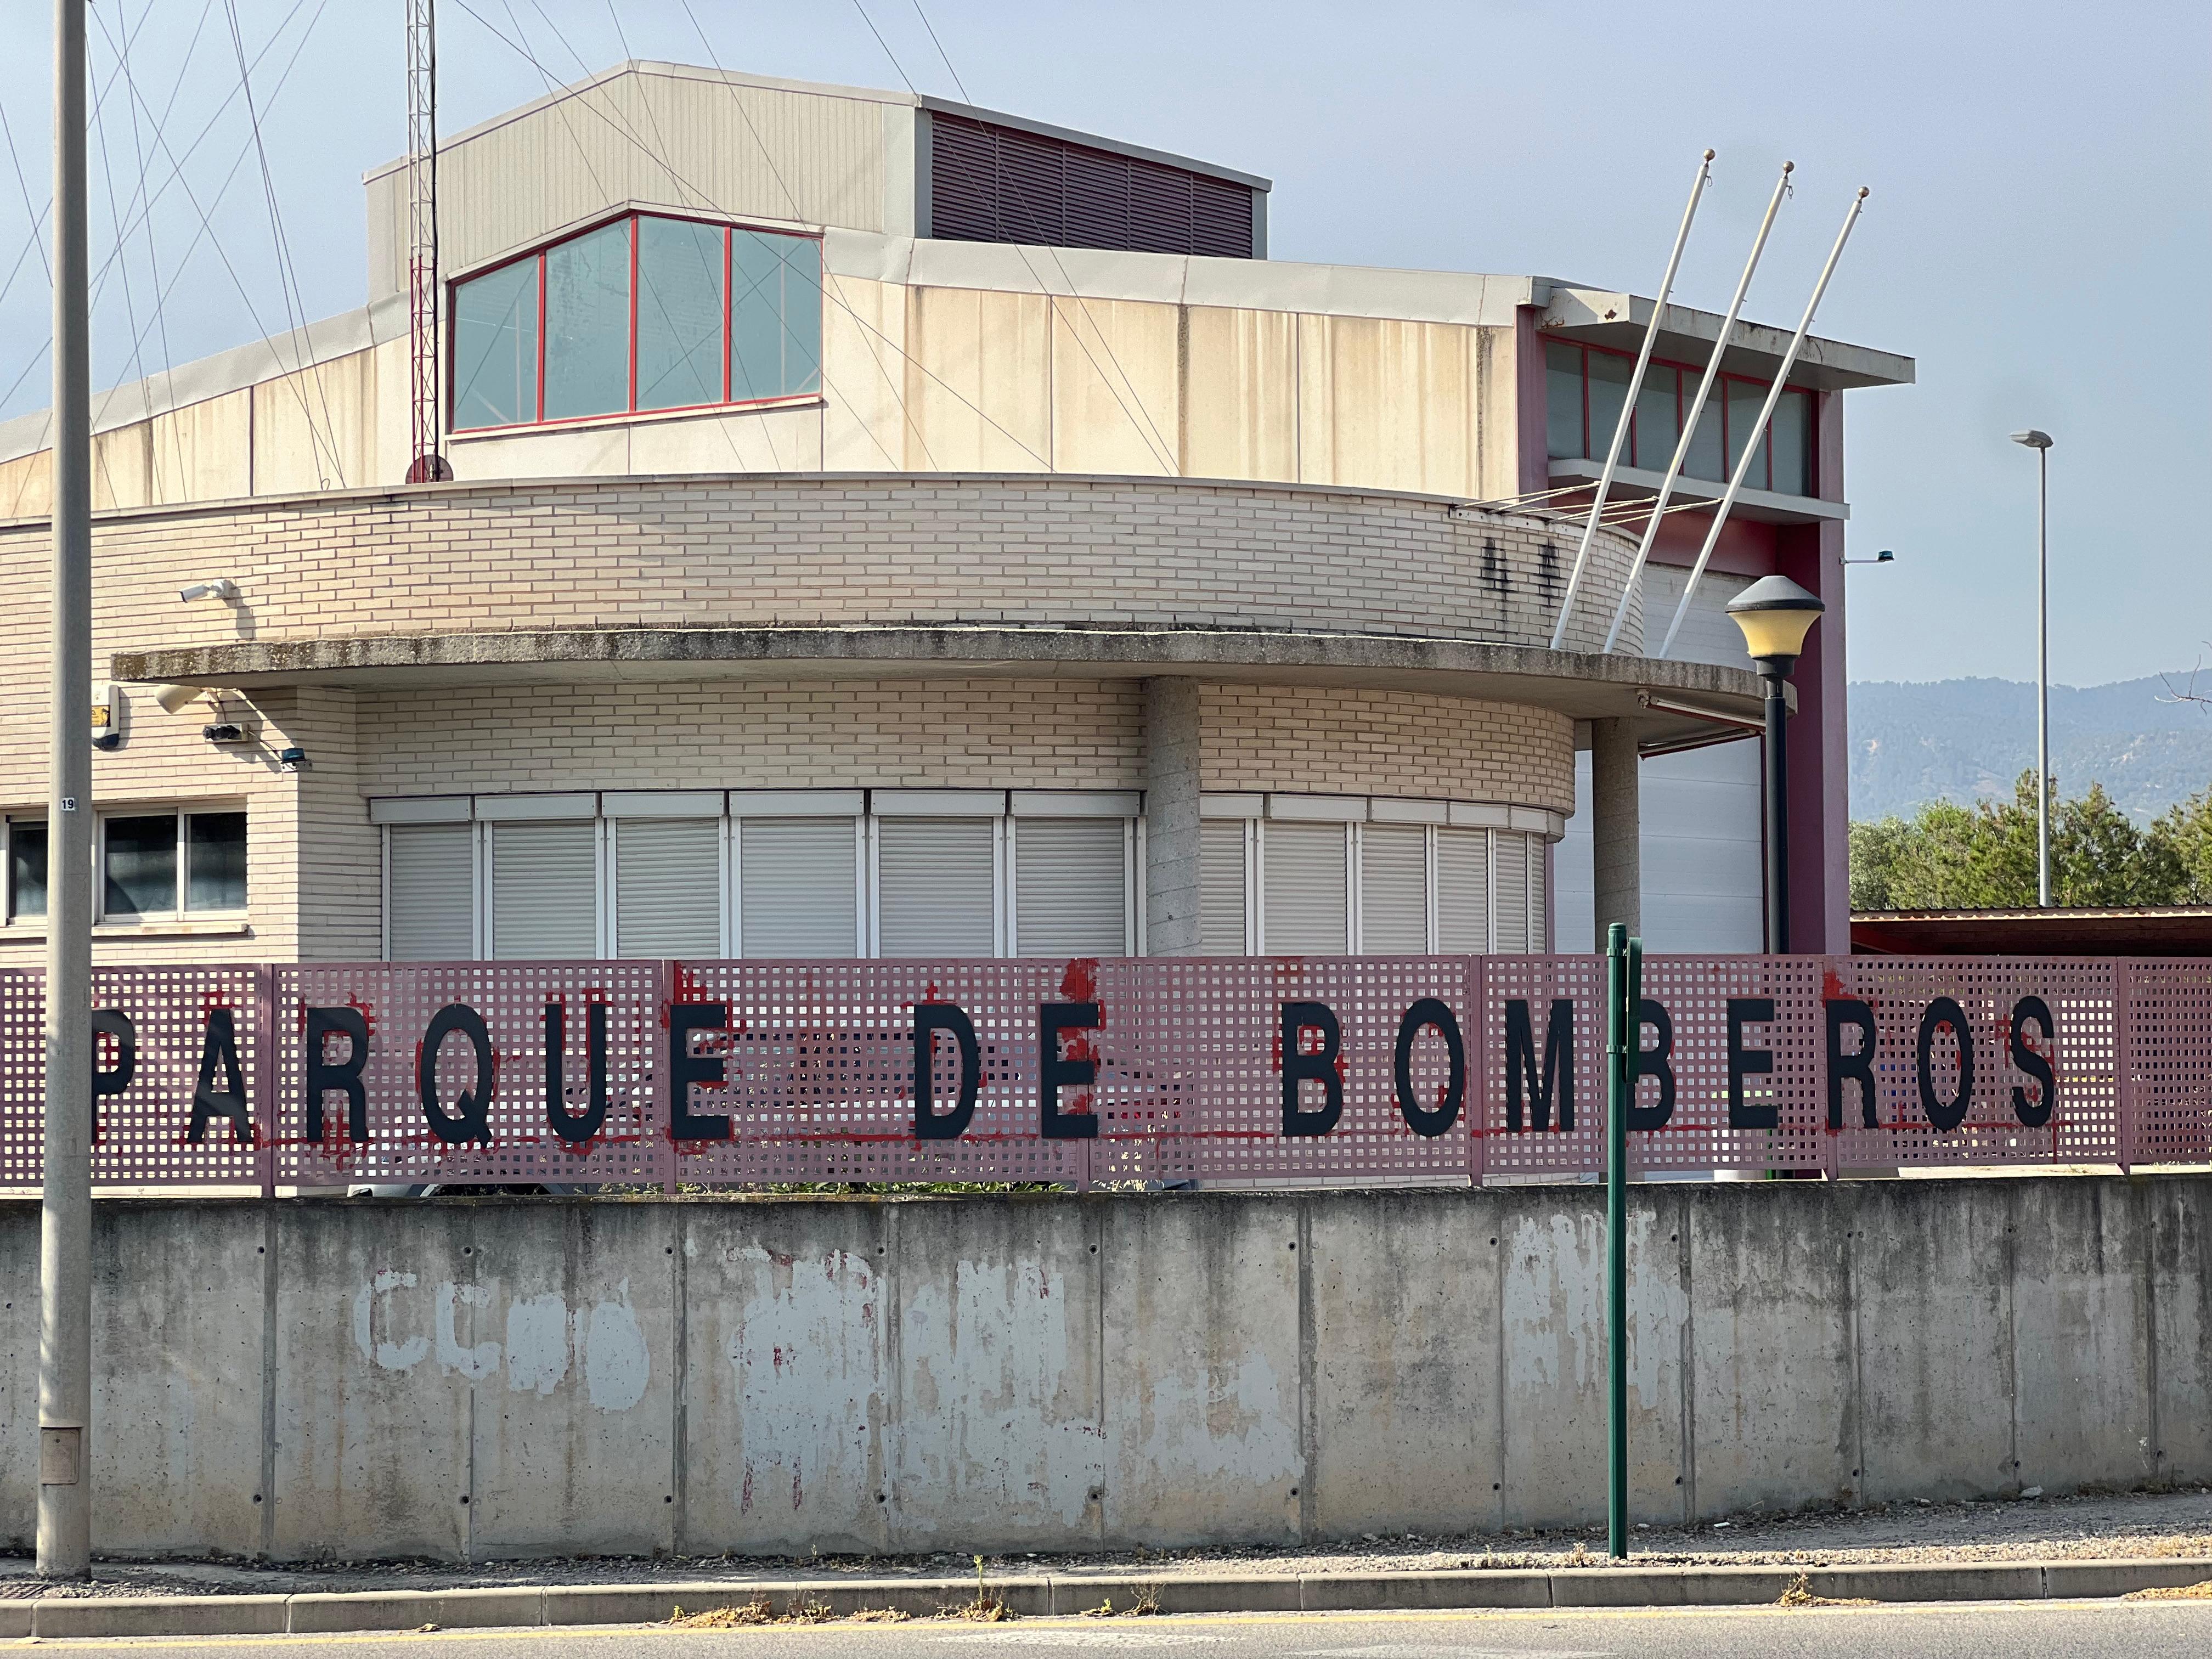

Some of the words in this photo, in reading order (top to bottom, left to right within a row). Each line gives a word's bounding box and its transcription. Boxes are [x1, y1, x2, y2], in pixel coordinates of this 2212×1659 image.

[62, 799, 74, 809] 19
[91, 1003, 731, 1148] PARQUE
[914, 1002, 1099, 1139] DE
[1282, 996, 2055, 1138] BOMBEROS
